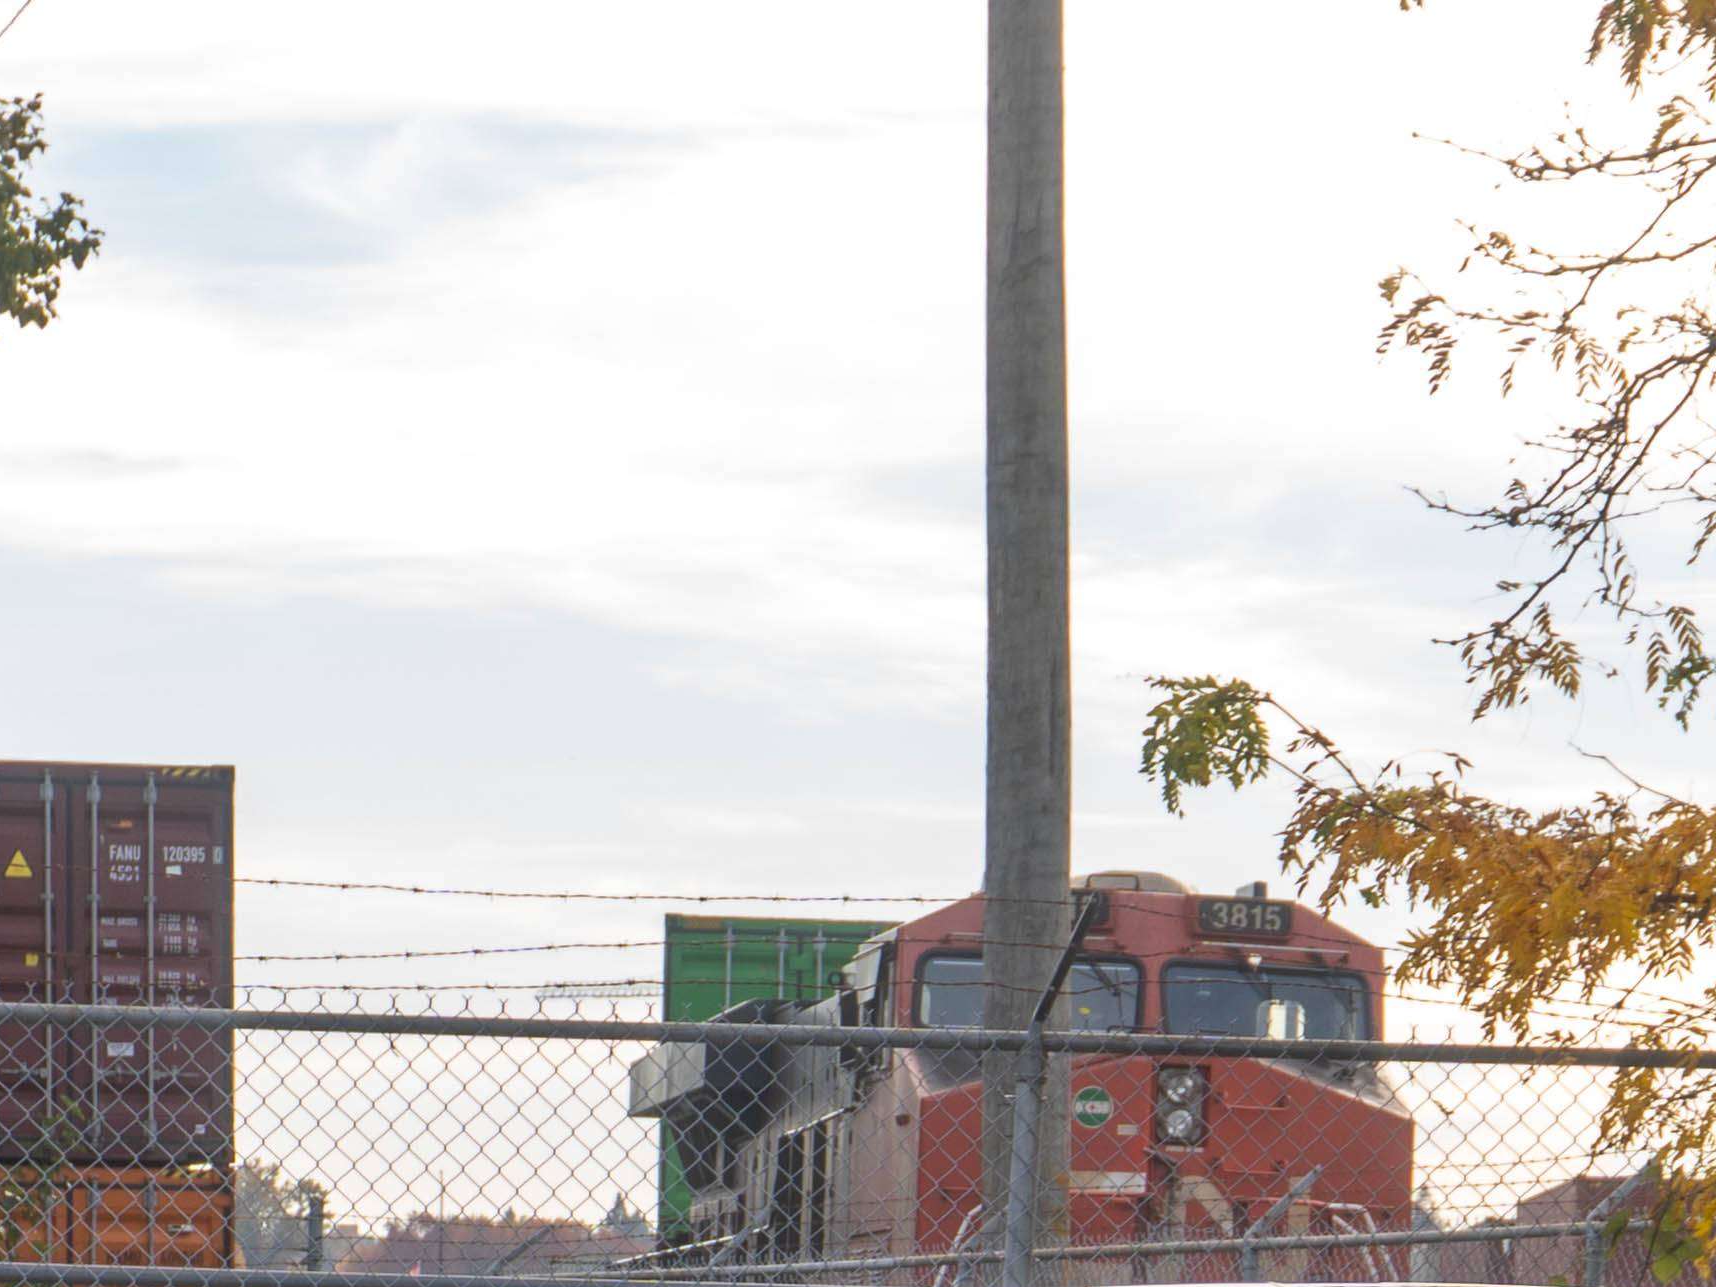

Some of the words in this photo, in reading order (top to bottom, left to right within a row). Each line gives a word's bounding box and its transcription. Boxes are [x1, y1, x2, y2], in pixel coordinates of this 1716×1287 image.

[109, 844, 141, 862] FANU
[163, 845, 206, 863] 120395
[1210, 902, 1282, 932] 3815
